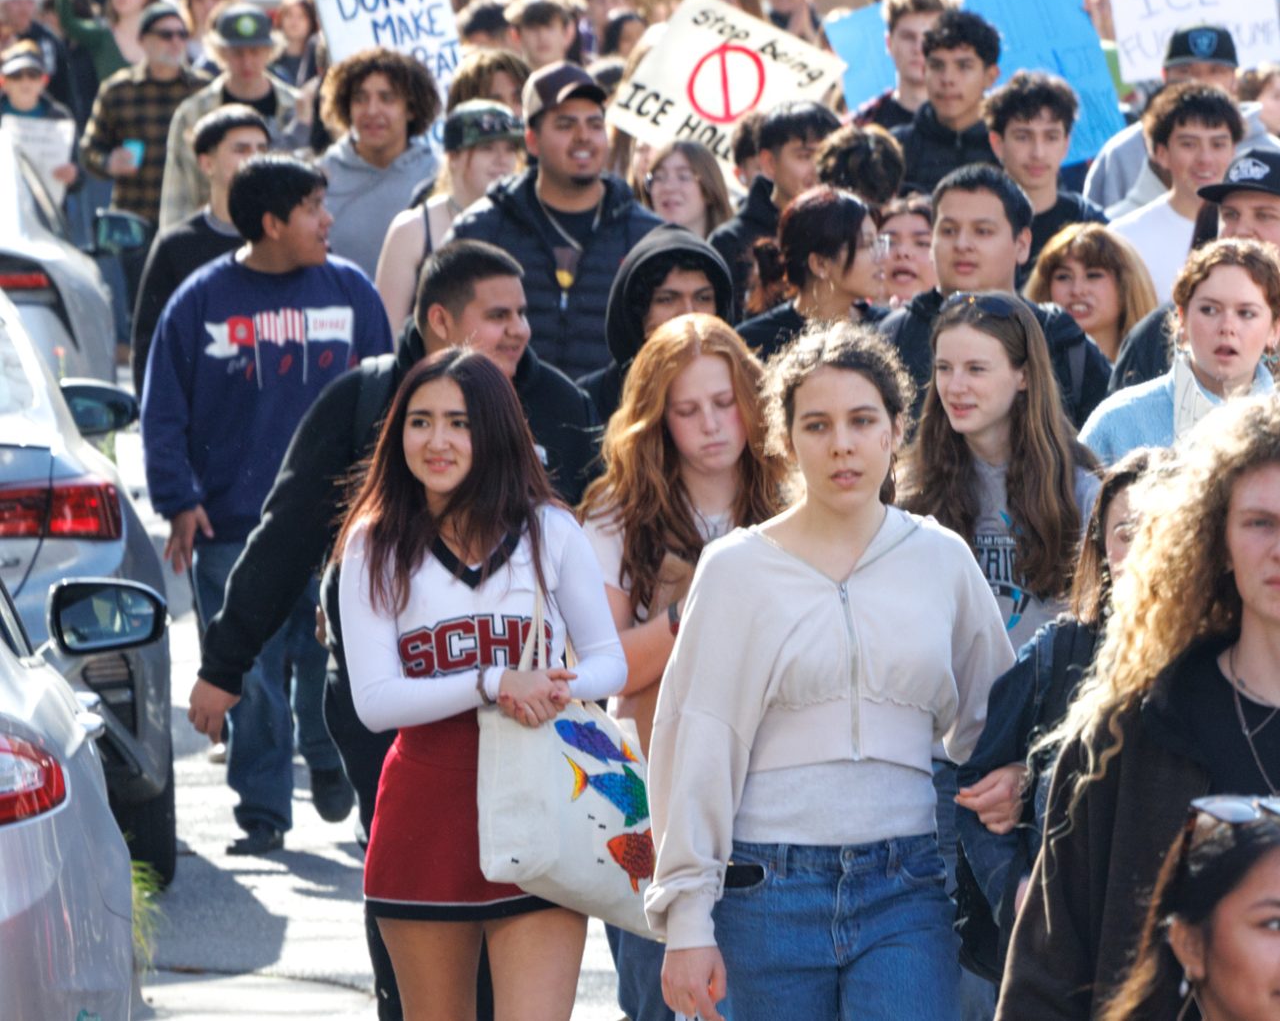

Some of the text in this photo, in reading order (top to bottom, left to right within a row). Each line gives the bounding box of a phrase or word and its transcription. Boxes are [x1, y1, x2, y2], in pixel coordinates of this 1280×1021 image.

[371, 3, 445, 46] MAKE
[617, 82, 675, 126] ICE
[398, 613, 554, 679] SCHS
